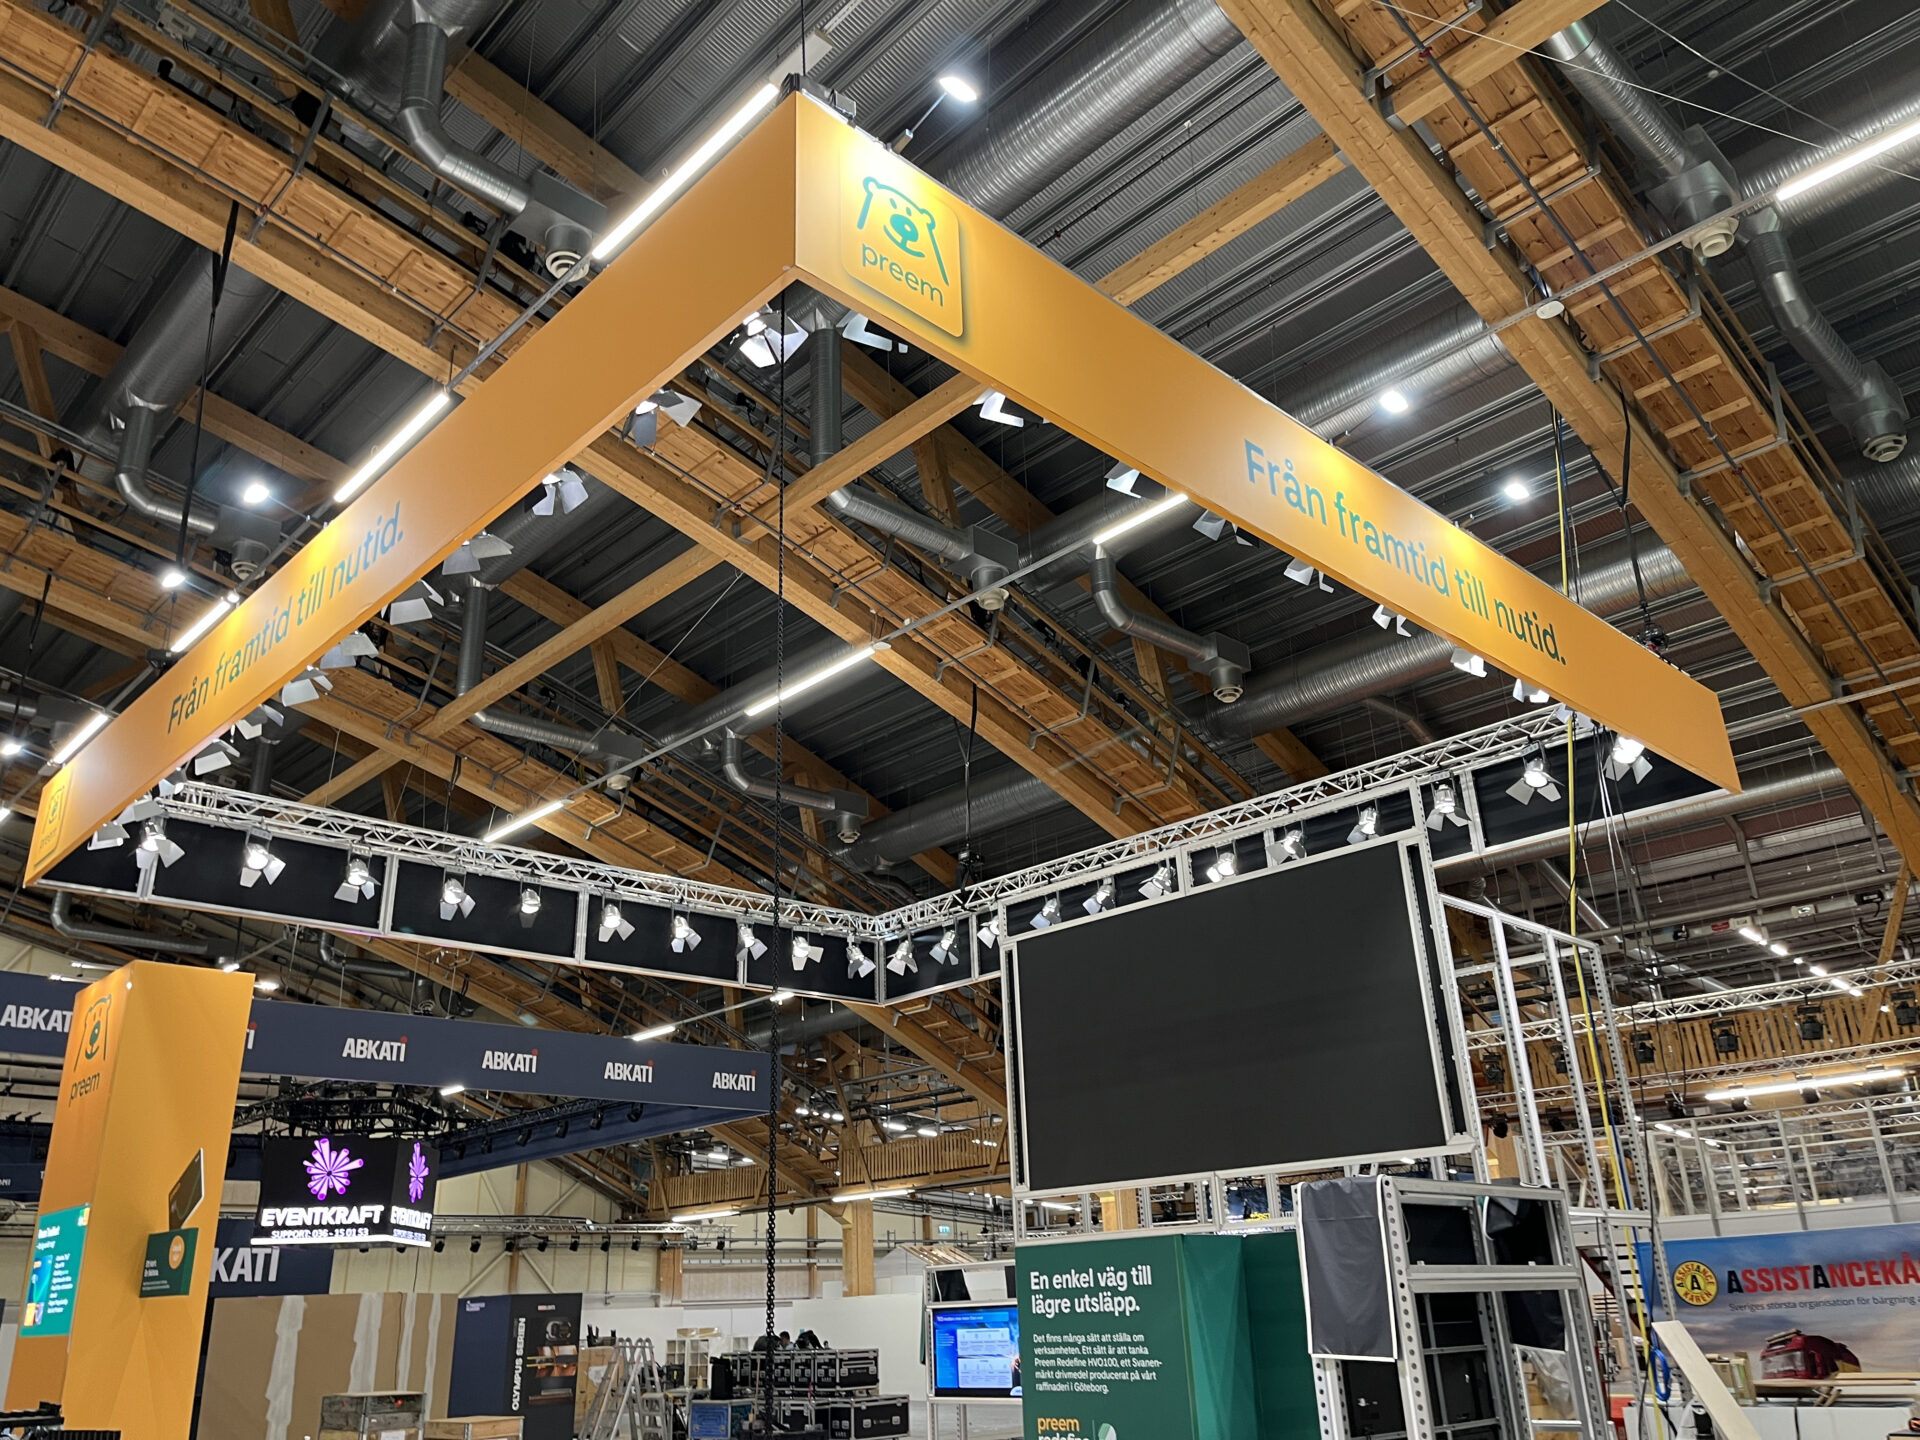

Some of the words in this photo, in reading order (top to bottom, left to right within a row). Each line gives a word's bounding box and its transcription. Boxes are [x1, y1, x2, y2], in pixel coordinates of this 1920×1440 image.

[862, 243, 944, 307] preem
[1244, 439, 1327, 526] Från
[1334, 491, 1450, 598] framtid
[1453, 569, 1489, 620] till
[1494, 597, 1567, 666] nutid.
[167, 676, 210, 734] Från
[213, 595, 293, 697] framtid
[296, 566, 327, 626] till
[329, 500, 404, 600] nutid.
[0, 1004, 74, 1034] ABKAT
[68, 1072, 101, 1107] preem
[260, 1205, 385, 1226] EVENTKRAFT
[209, 1247, 280, 1282] KATI
[1030, 1271, 1049, 1290] En
[1052, 1268, 1095, 1289] enkel
[1097, 1266, 1128, 1292] väg
[1130, 1264, 1152, 1286] till
[1727, 1250, 1920, 1294] ASSISTANCEKÅ
[1031, 1293, 1072, 1319] lägre
[1074, 1291, 1141, 1317] utsläpp.
[1728, 1303, 1765, 1312] Sveriges
[1766, 1301, 1797, 1310] största
[1799, 1297, 1854, 1309] organisation
[1856, 1296, 1870, 1305] för
[516, 1317, 526, 1356] SERIEN
[1033, 1334, 1045, 1343] Det
[1046, 1333, 1062, 1343] finns
[1062, 1333, 1086, 1344] många
[1086, 1333, 1101, 1342] sätt
[1101, 1333, 1112, 1342] att
[1112, 1332, 1132, 1342] ställa
[1132, 1334, 1145, 1342] om
[1033, 1345, 1082, 1355] verksamheten.
[1081, 1345, 1093, 1354] Ett
[1092, 1345, 1108, 1355] sätt
[1107, 1345, 1117, 1354] är
[1116, 1345, 1128, 1354] att
[1128, 1345, 1149, 1355] tanka
[1034, 1357, 1056, 1367] Preem
[1056, 1358, 1087, 1367] Redefine
[1087, 1358, 1120, 1368] HVO100,
[1120, 1358, 1132, 1367] ett
[1131, 1358, 1163, 1368] Svanen-
[1034, 1370, 1055, 1379] märkt
[1054, 1370, 1089, 1379] drivmedel
[1089, 1370, 1130, 1381] producerat
[1130, 1370, 1141, 1382] på
[1140, 1370, 1157, 1381] vårt
[512, 1357, 523, 1411] OLYMPUS
[1035, 1382, 1071, 1392] raffinaderi
[1073, 1382, 1110, 1394] Göteborg.
[1037, 1417, 1080, 1434] preem
